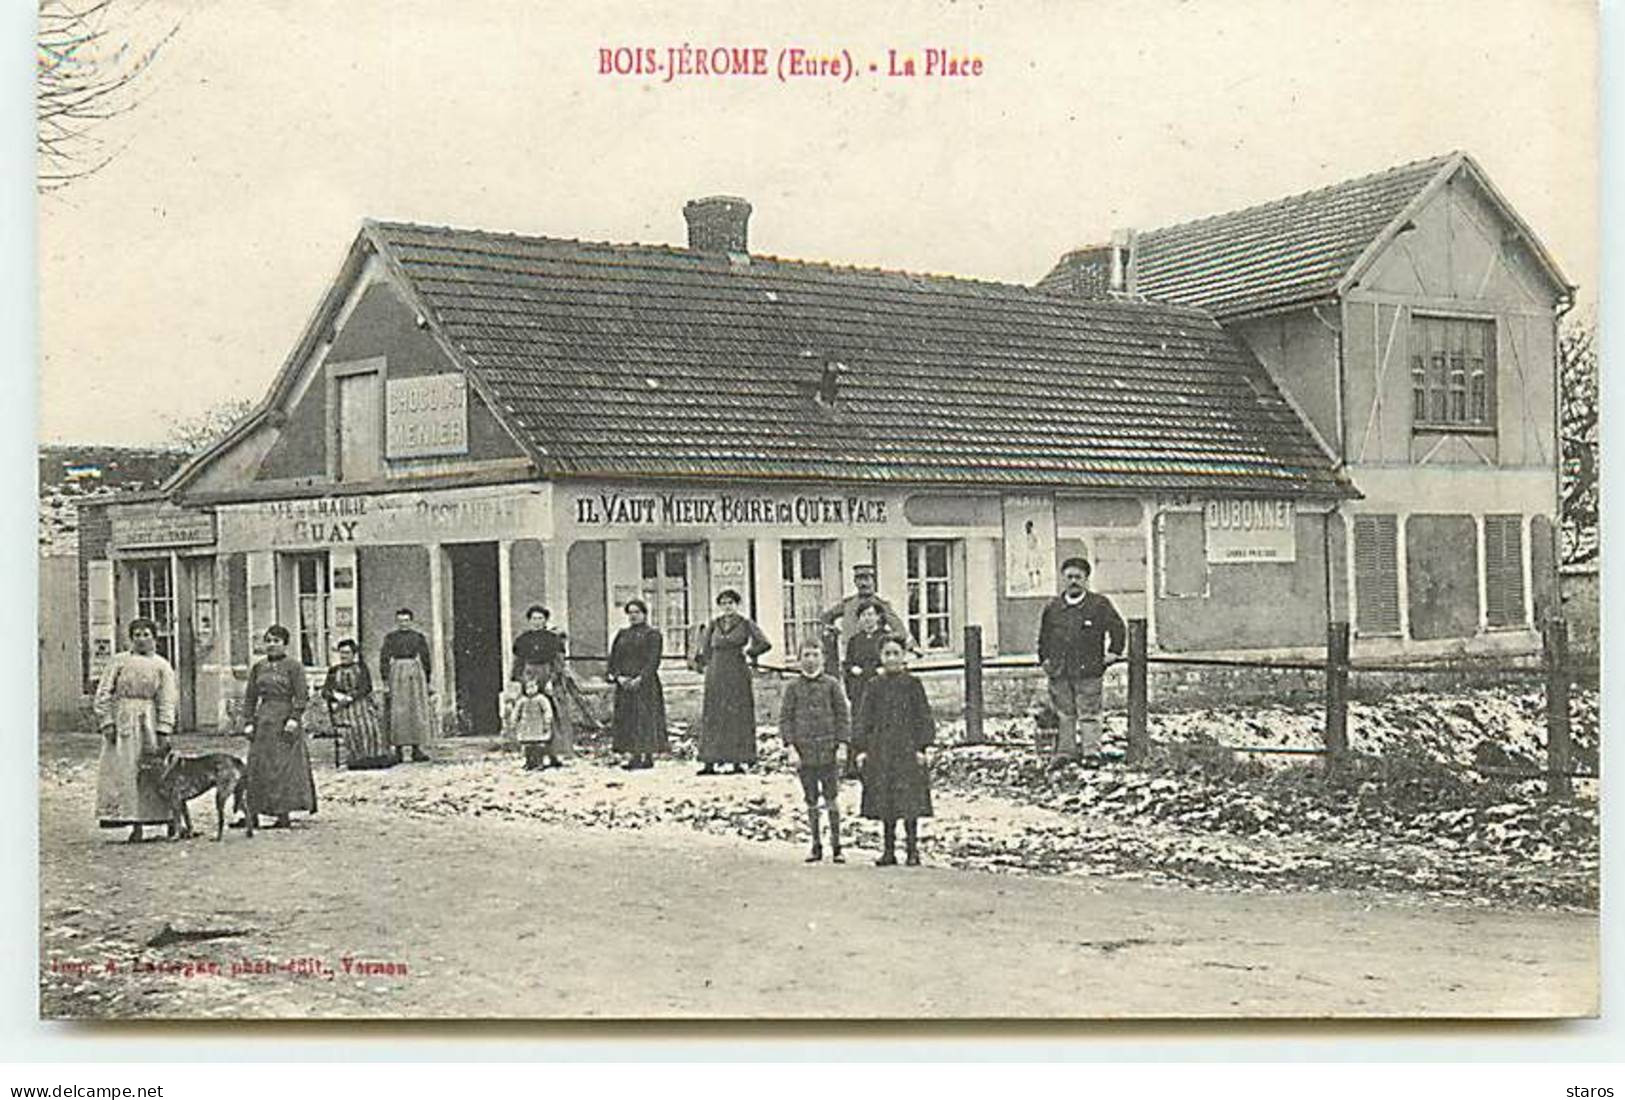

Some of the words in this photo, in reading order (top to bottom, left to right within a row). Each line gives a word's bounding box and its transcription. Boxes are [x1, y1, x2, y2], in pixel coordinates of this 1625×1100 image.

[577, 498, 599, 523] IL
[600, 494, 655, 523] VAUT
[661, 495, 718, 524] MIEUX
[721, 495, 775, 523] BOIRE
[847, 496, 887, 525] FACE
[1206, 498, 1294, 532] DUBONNET
